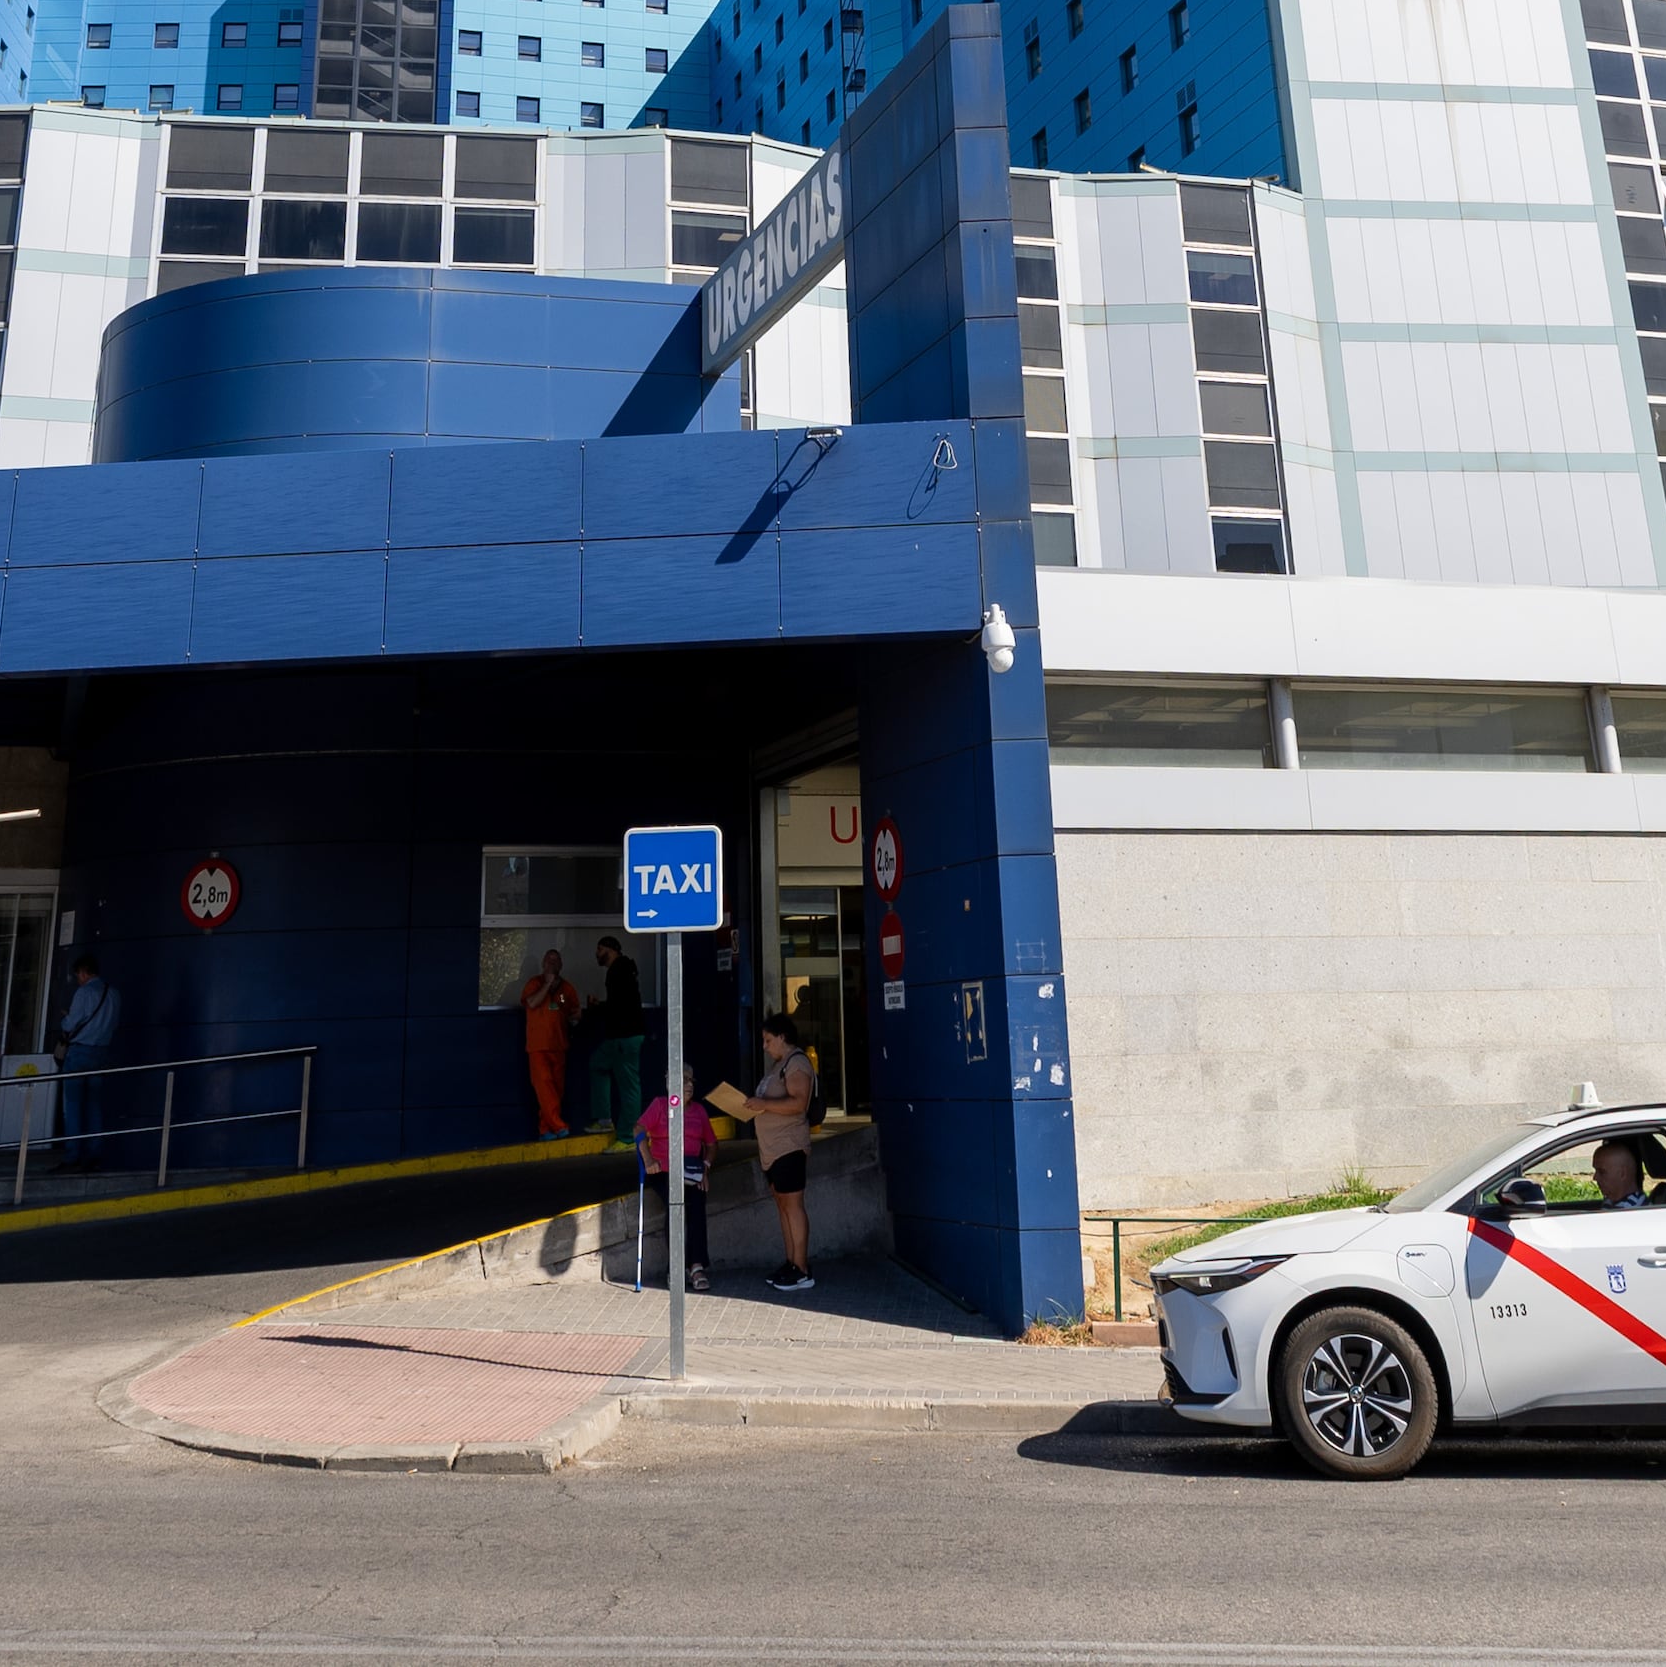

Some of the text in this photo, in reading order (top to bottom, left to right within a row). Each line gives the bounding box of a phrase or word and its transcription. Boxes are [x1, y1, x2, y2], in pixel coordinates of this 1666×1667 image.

[708, 152, 843, 356] URGENCIAS
[633, 863, 712, 895] TAXI
[192, 883, 229, 907] 2,8m
[1490, 1303, 1527, 1319] 13313
